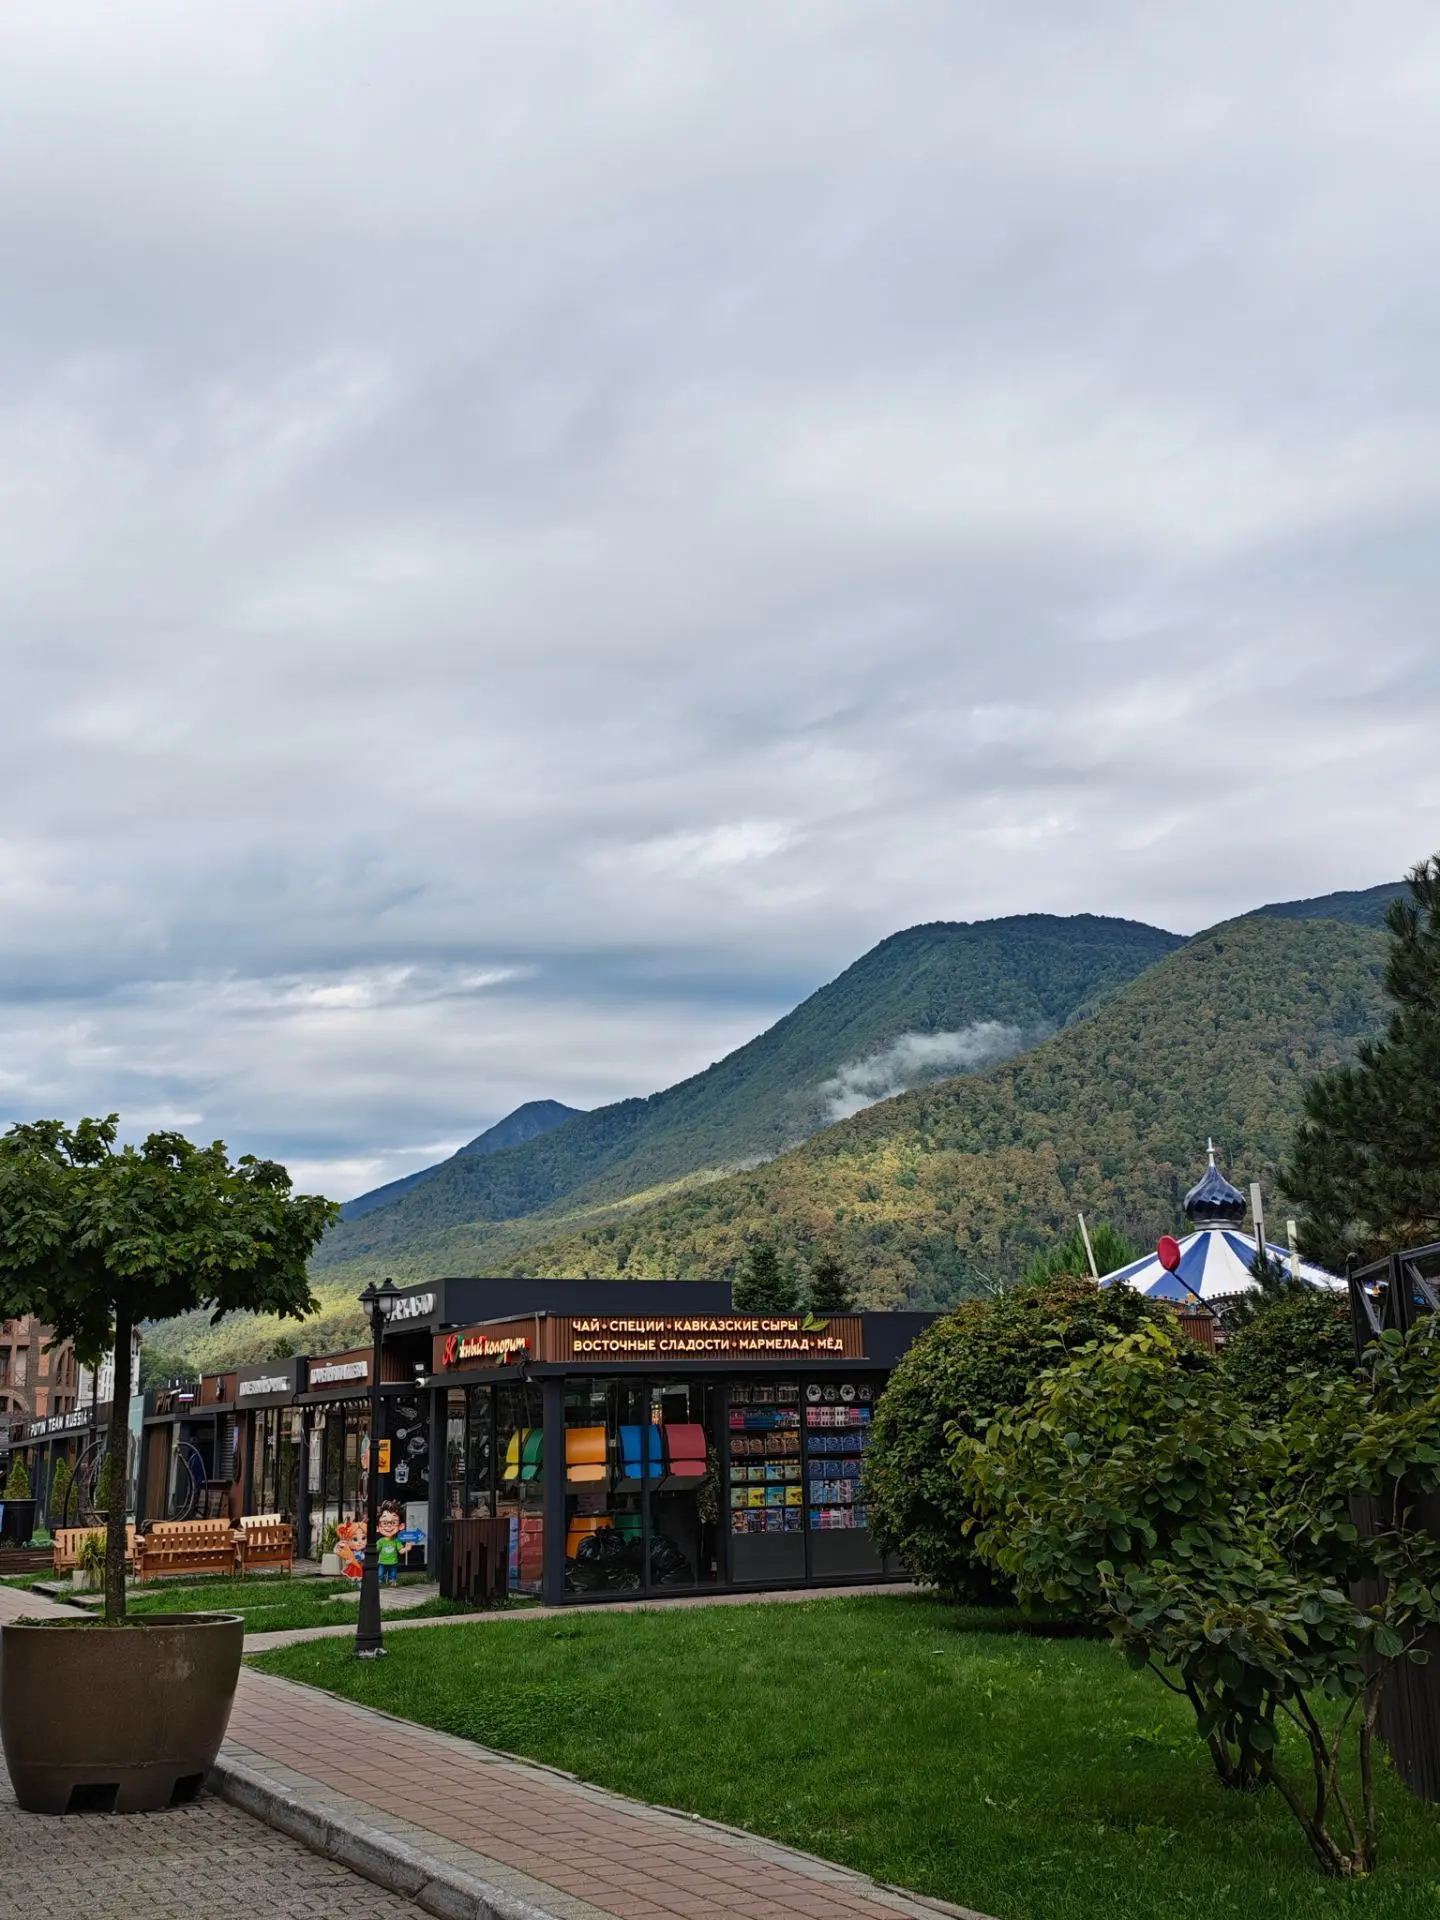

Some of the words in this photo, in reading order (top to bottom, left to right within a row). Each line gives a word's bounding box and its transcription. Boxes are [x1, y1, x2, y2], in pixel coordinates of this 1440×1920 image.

[573, 1319, 600, 1331] ЧАЙ
[610, 1321, 664, 1333] СПЕЦИИ
[674, 1320, 759, 1331] КАВКАЗСКИЕ
[761, 1320, 798, 1331] СЫРЫ
[484, 1337, 526, 1364] колорит
[573, 1340, 656, 1351] ВОСТОЧНЫЕ
[660, 1339, 730, 1351] СЛАДОСТИ
[740, 1339, 809, 1350] МАРМЕЛАД
[817, 1337, 843, 1350] МЁД
[48, 1415, 64, 1432] TEAM
[64, 1409, 88, 1429] RUSSIA
